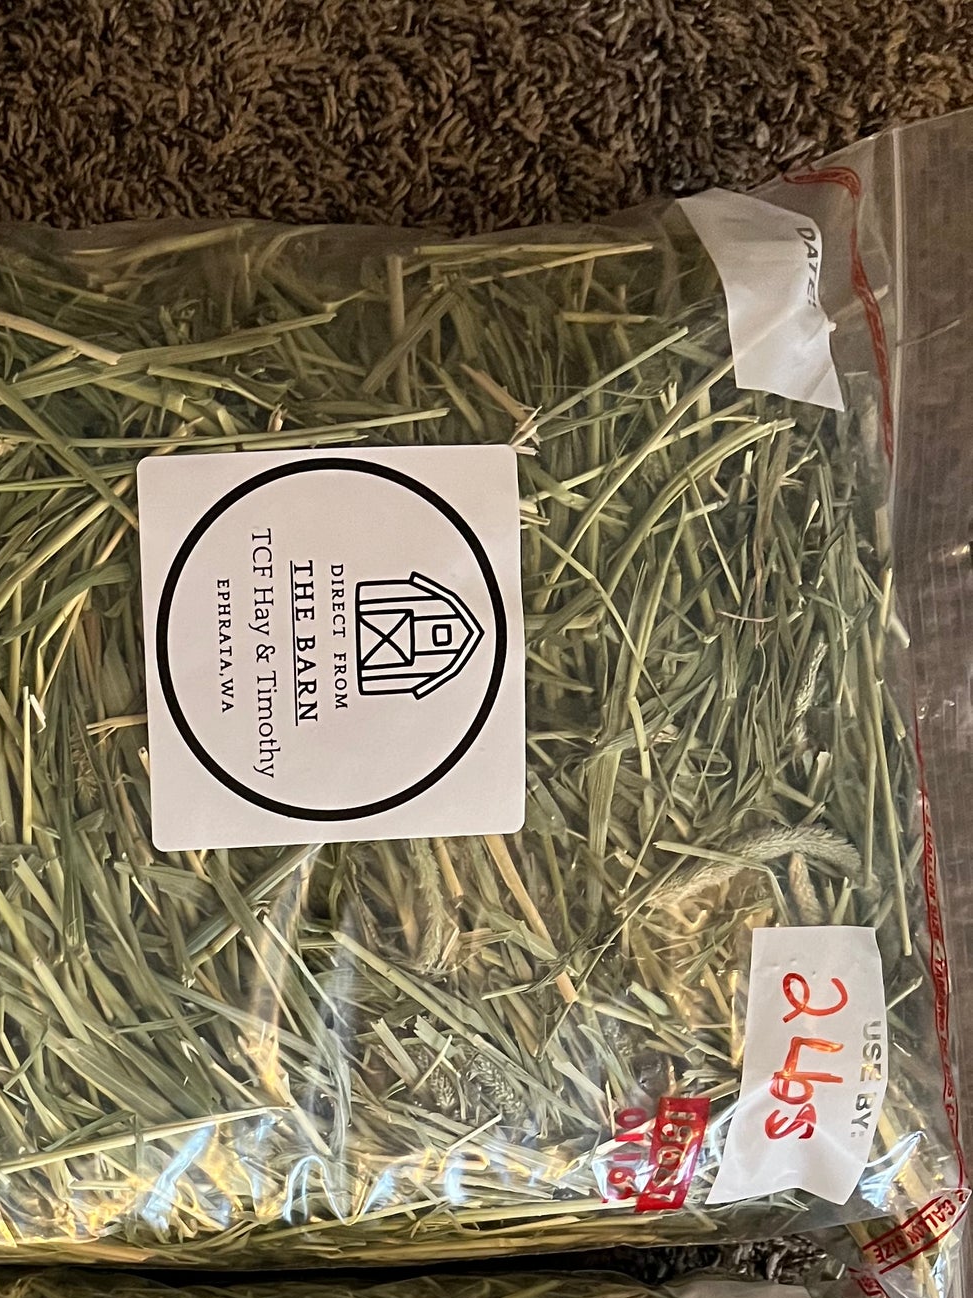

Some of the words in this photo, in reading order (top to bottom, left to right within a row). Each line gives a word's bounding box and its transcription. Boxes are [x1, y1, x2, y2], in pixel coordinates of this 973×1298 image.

[796, 227, 819, 308] DATE:
[252, 529, 273, 577] TCF
[248, 586, 275, 636] Hay
[293, 560, 315, 622] THE
[330, 564, 345, 638] DIRECT
[217, 579, 234, 713] EPHRATA,WA
[256, 644, 275, 662] &
[296, 636, 318, 723] BARN
[333, 653, 347, 710] FROM
[253, 671, 281, 778] Timothy
[782, 972, 849, 1023] 2
[859, 1019, 883, 1082] USE
[850, 1093, 877, 1138] BY:
[872, 1235, 906, 1264] SIZE
[904, 1199, 957, 1245] GALLON
